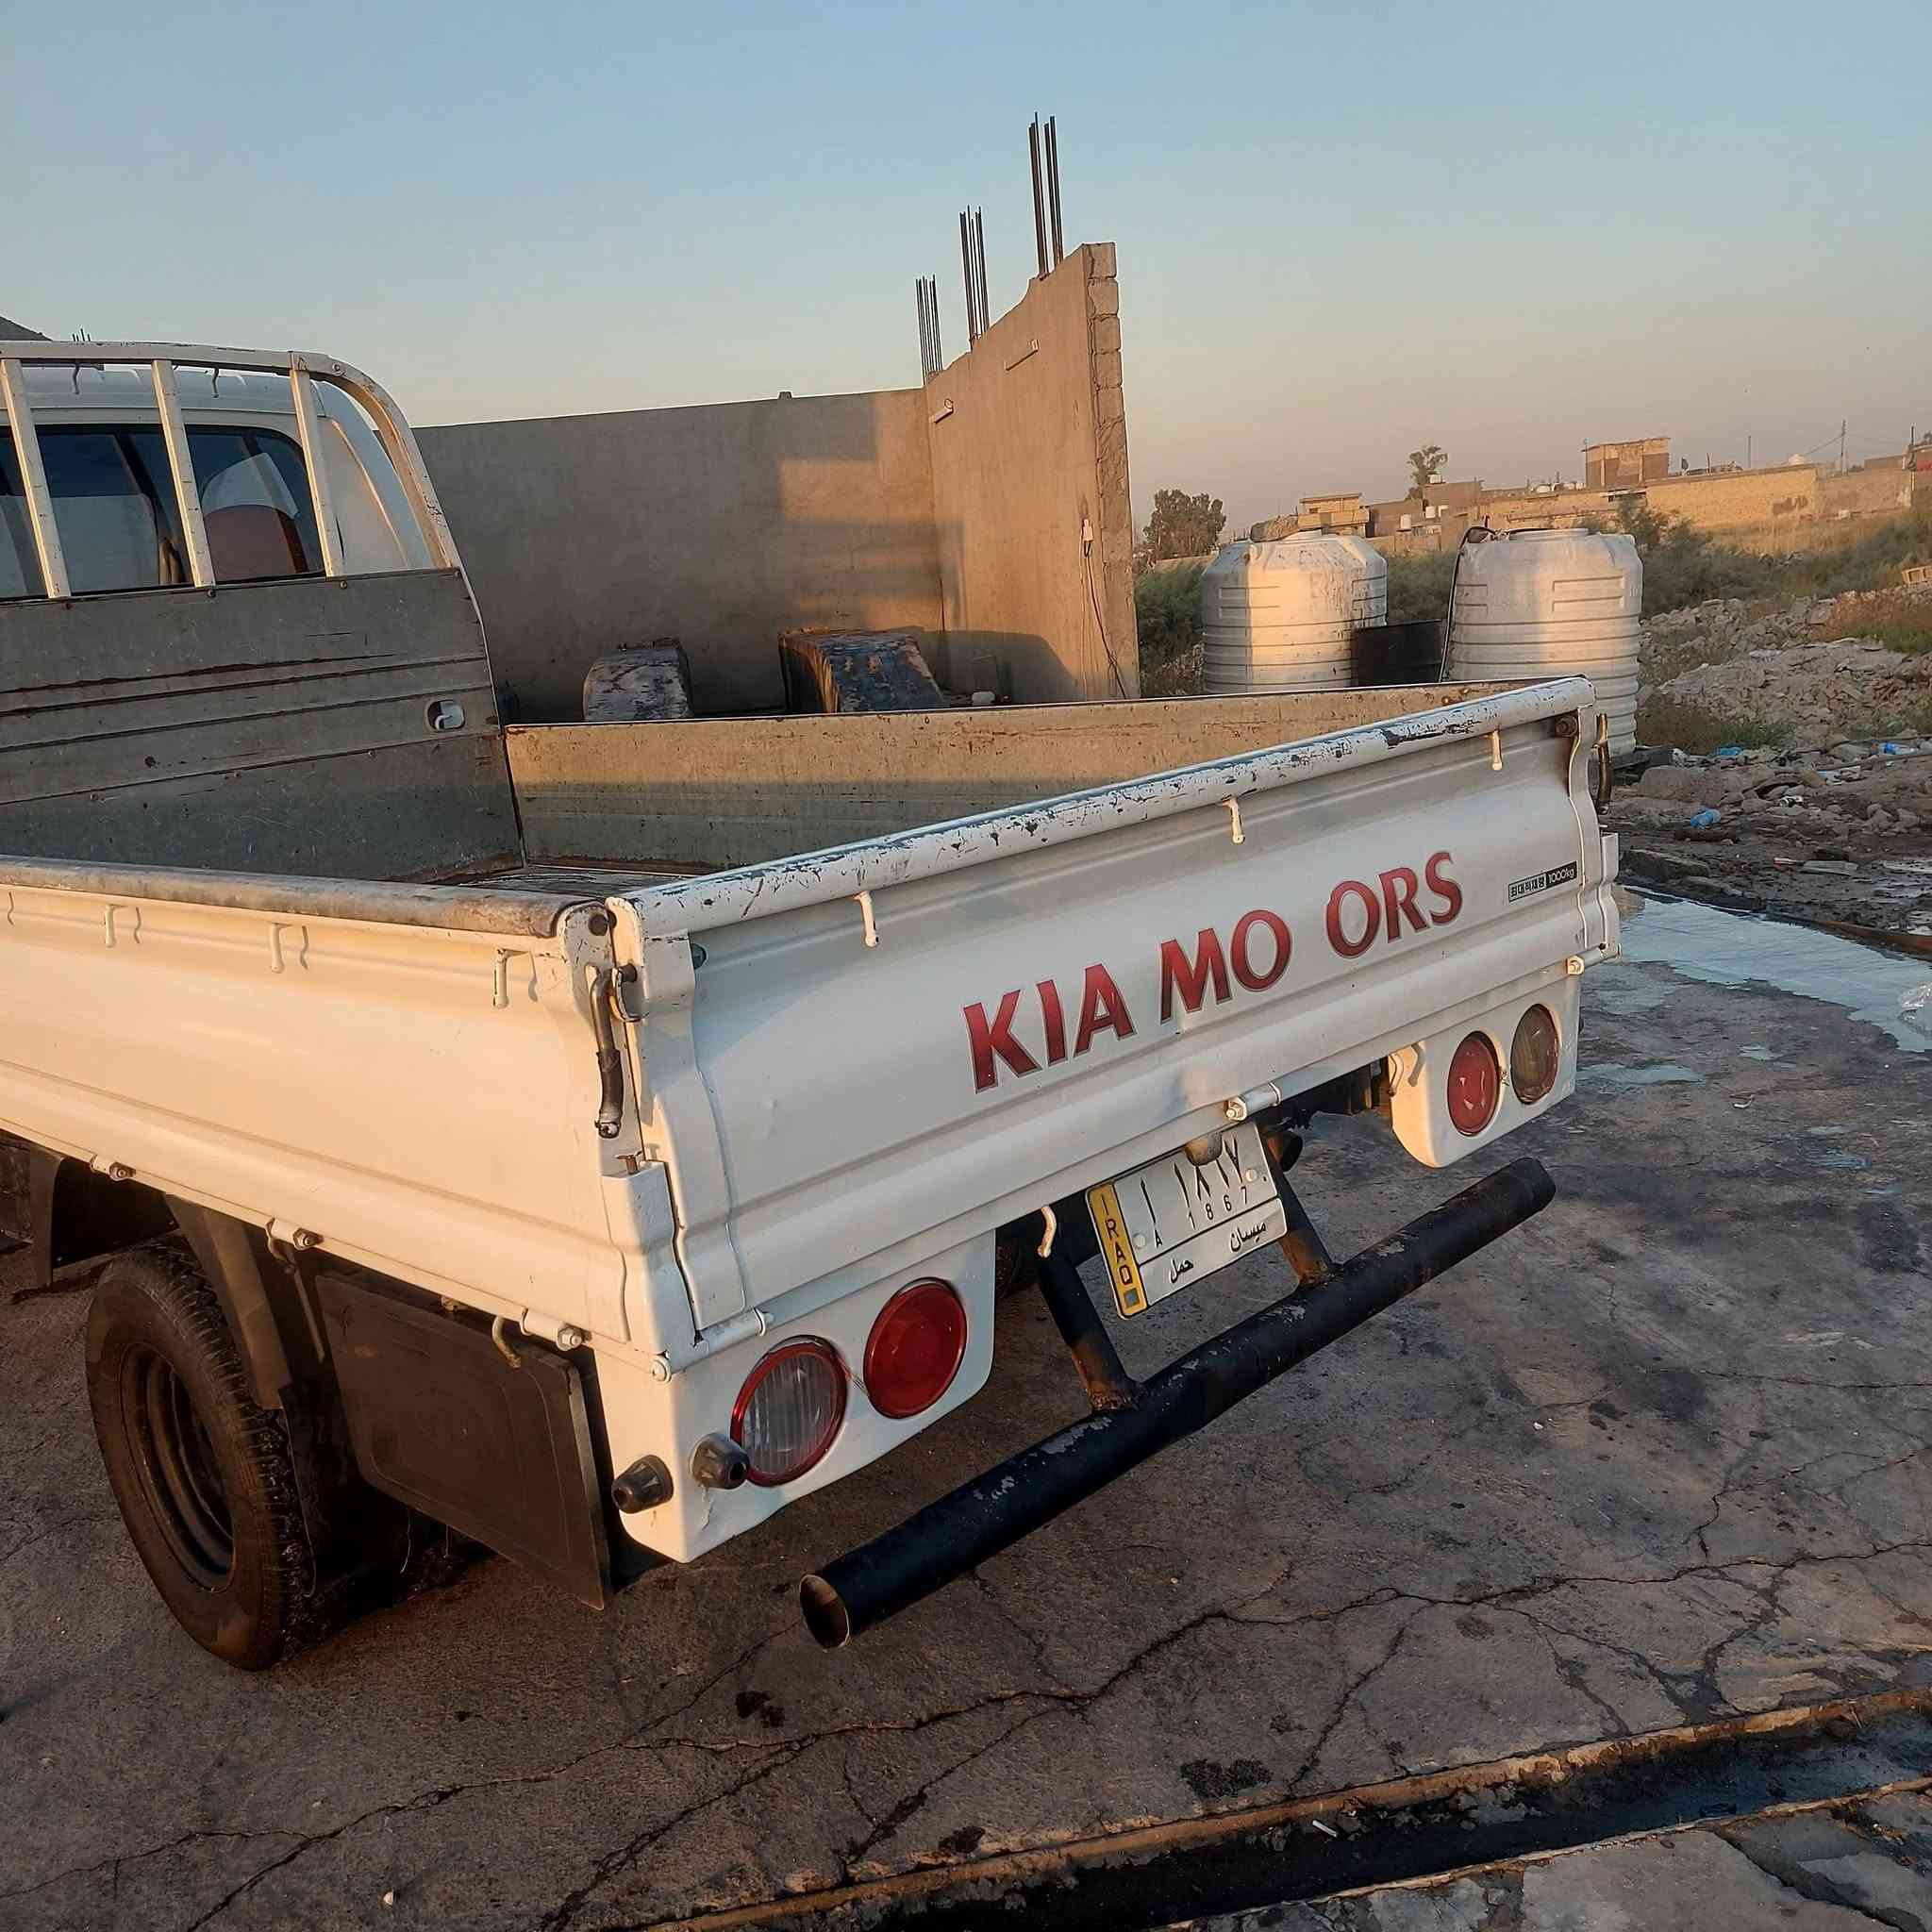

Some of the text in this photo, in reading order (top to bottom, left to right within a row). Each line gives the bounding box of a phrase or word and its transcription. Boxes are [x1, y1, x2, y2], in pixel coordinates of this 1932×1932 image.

[961, 962, 1137, 1094] KIA
[1100, 1192, 1133, 1287] IRAQ
[1154, 1185, 1248, 1249] A 1867
[1230, 1223, 1266, 1253] ميسان
[1170, 1258, 1194, 1284] حمل
